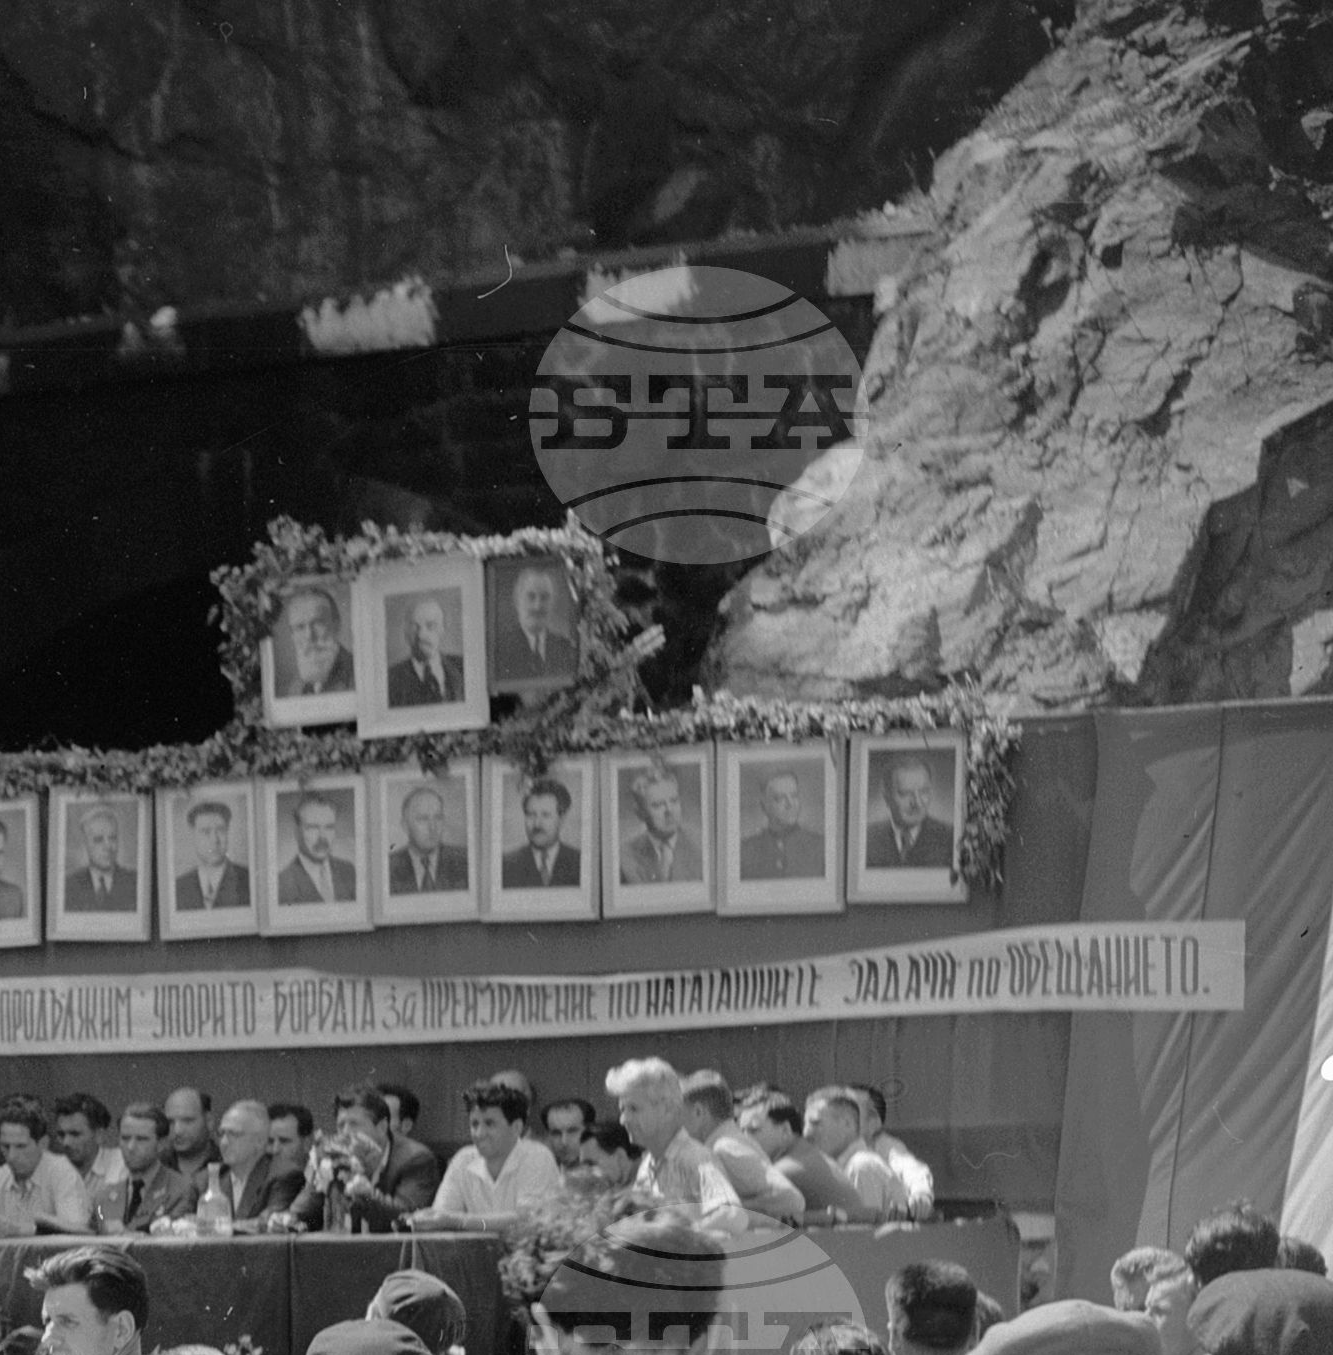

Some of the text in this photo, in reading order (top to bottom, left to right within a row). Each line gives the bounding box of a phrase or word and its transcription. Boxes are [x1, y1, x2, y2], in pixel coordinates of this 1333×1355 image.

[151, 980, 257, 1039] УПОРИТО
[273, 977, 376, 1035] БОРБАТА
[843, 950, 958, 1006] ЗАДАЧИ
